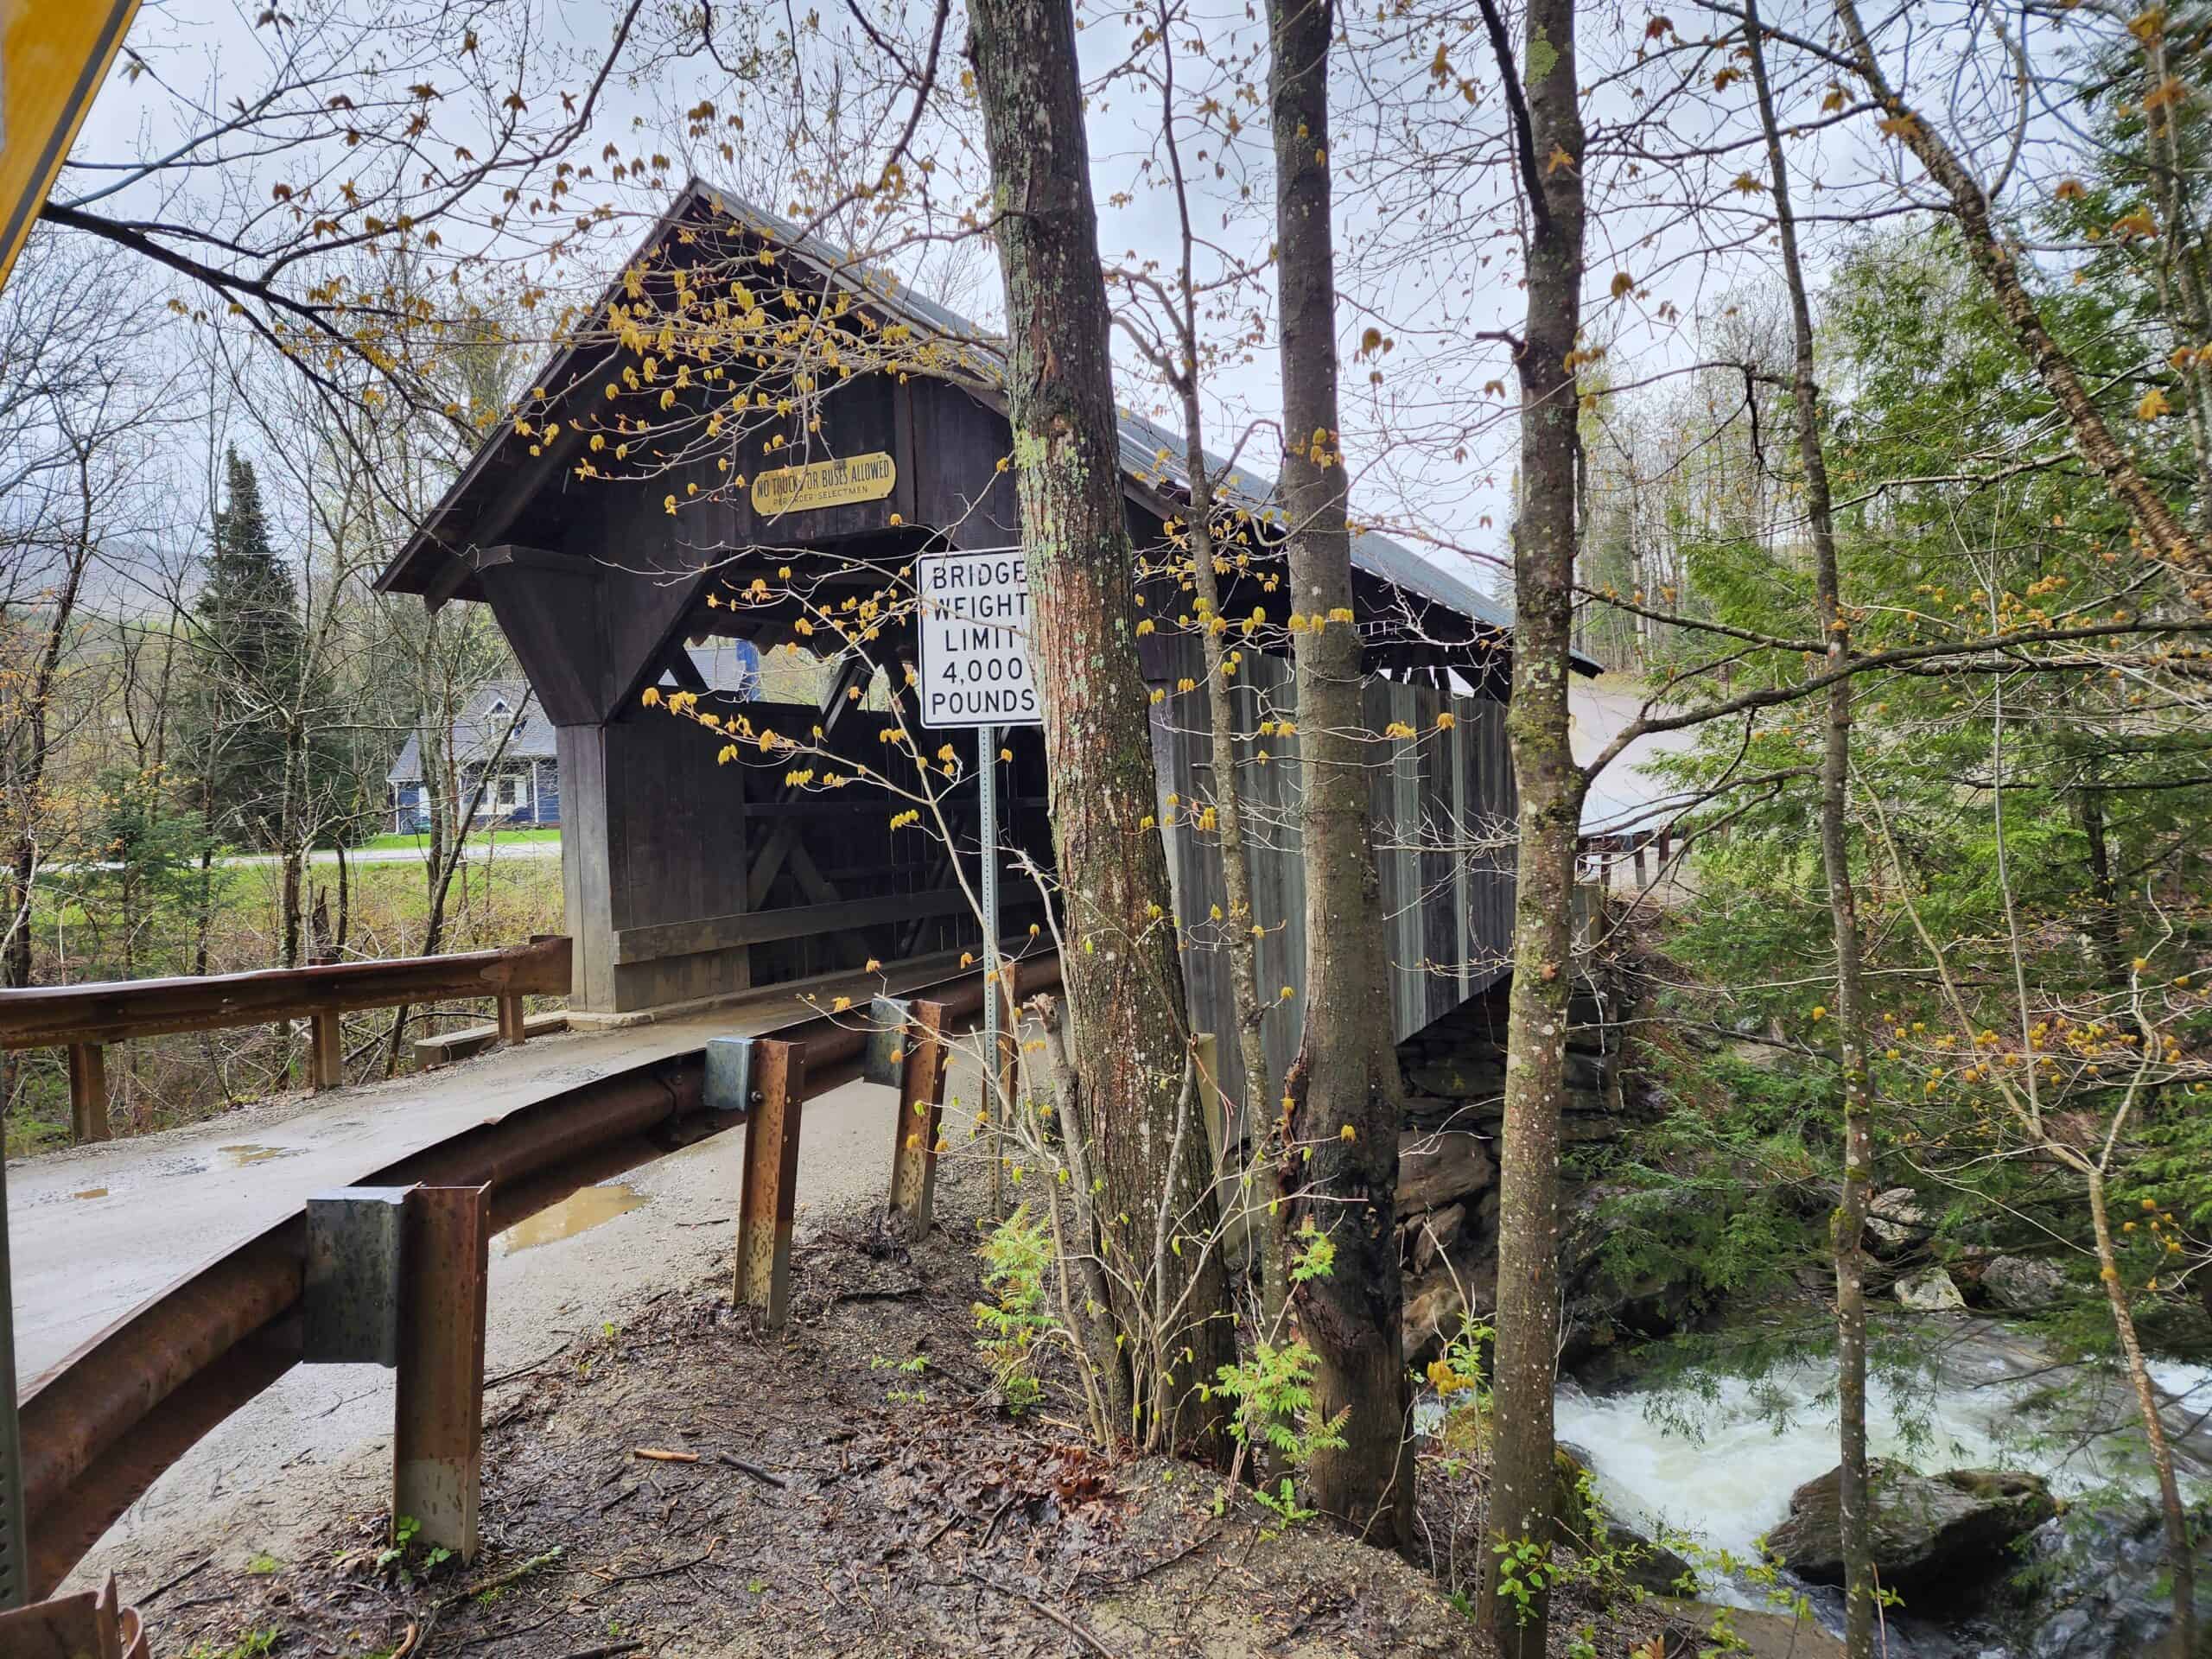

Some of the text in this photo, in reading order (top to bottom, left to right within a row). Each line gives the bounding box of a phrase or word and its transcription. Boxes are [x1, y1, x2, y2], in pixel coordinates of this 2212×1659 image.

[757, 480, 769, 499] NO
[807, 472, 819, 490] OR
[822, 465, 849, 486] BUSES
[851, 460, 890, 482] ALLOWED
[817, 486, 869, 499] SELECTMEN
[933, 560, 1027, 589] BRIDGE
[934, 593, 1028, 621] WEIGHT
[945, 625, 1016, 652] LIMIT
[943, 657, 1023, 686] 4,000
[931, 688, 1034, 715] POUNDS
